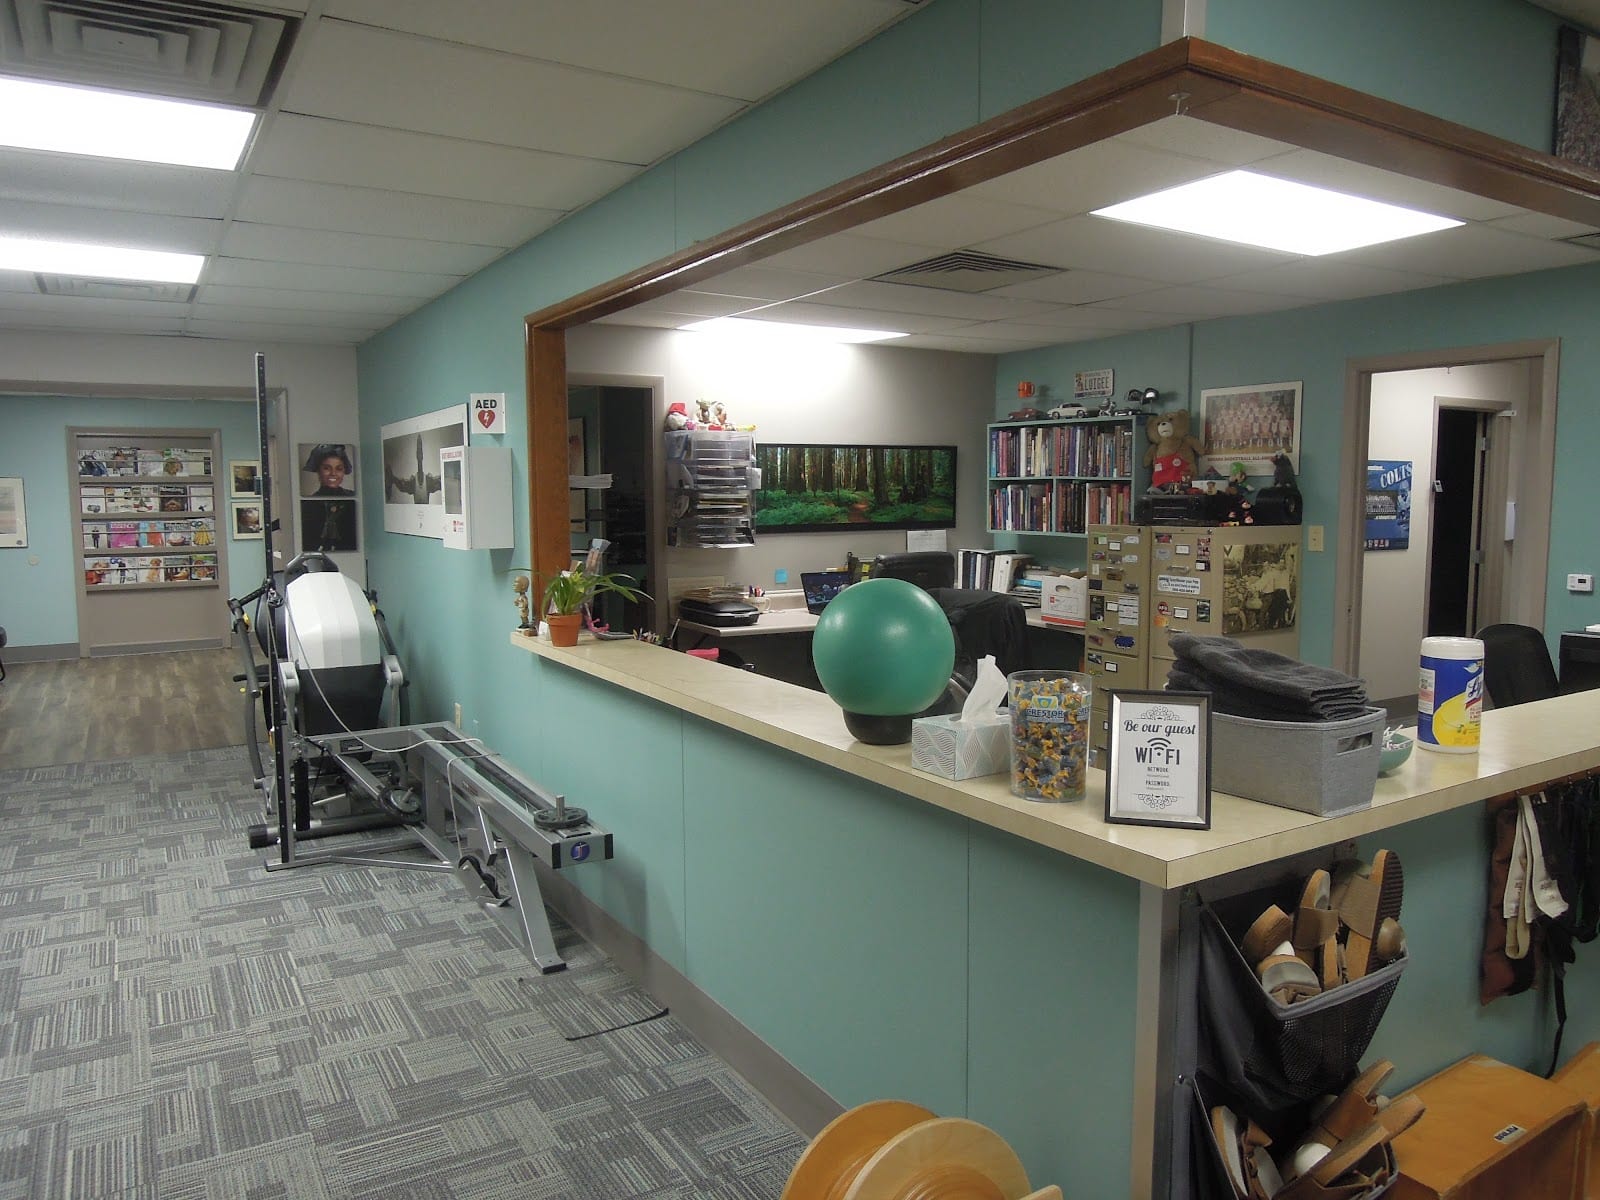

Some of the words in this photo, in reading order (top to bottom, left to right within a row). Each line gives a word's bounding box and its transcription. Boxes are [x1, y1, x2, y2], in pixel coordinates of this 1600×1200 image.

[475, 399, 497, 409] AED
[1380, 462, 1412, 488] COLTS
[1124, 720, 1139, 732] Be
[1141, 724, 1163, 733] our
[1164, 725, 1196, 737] guest
